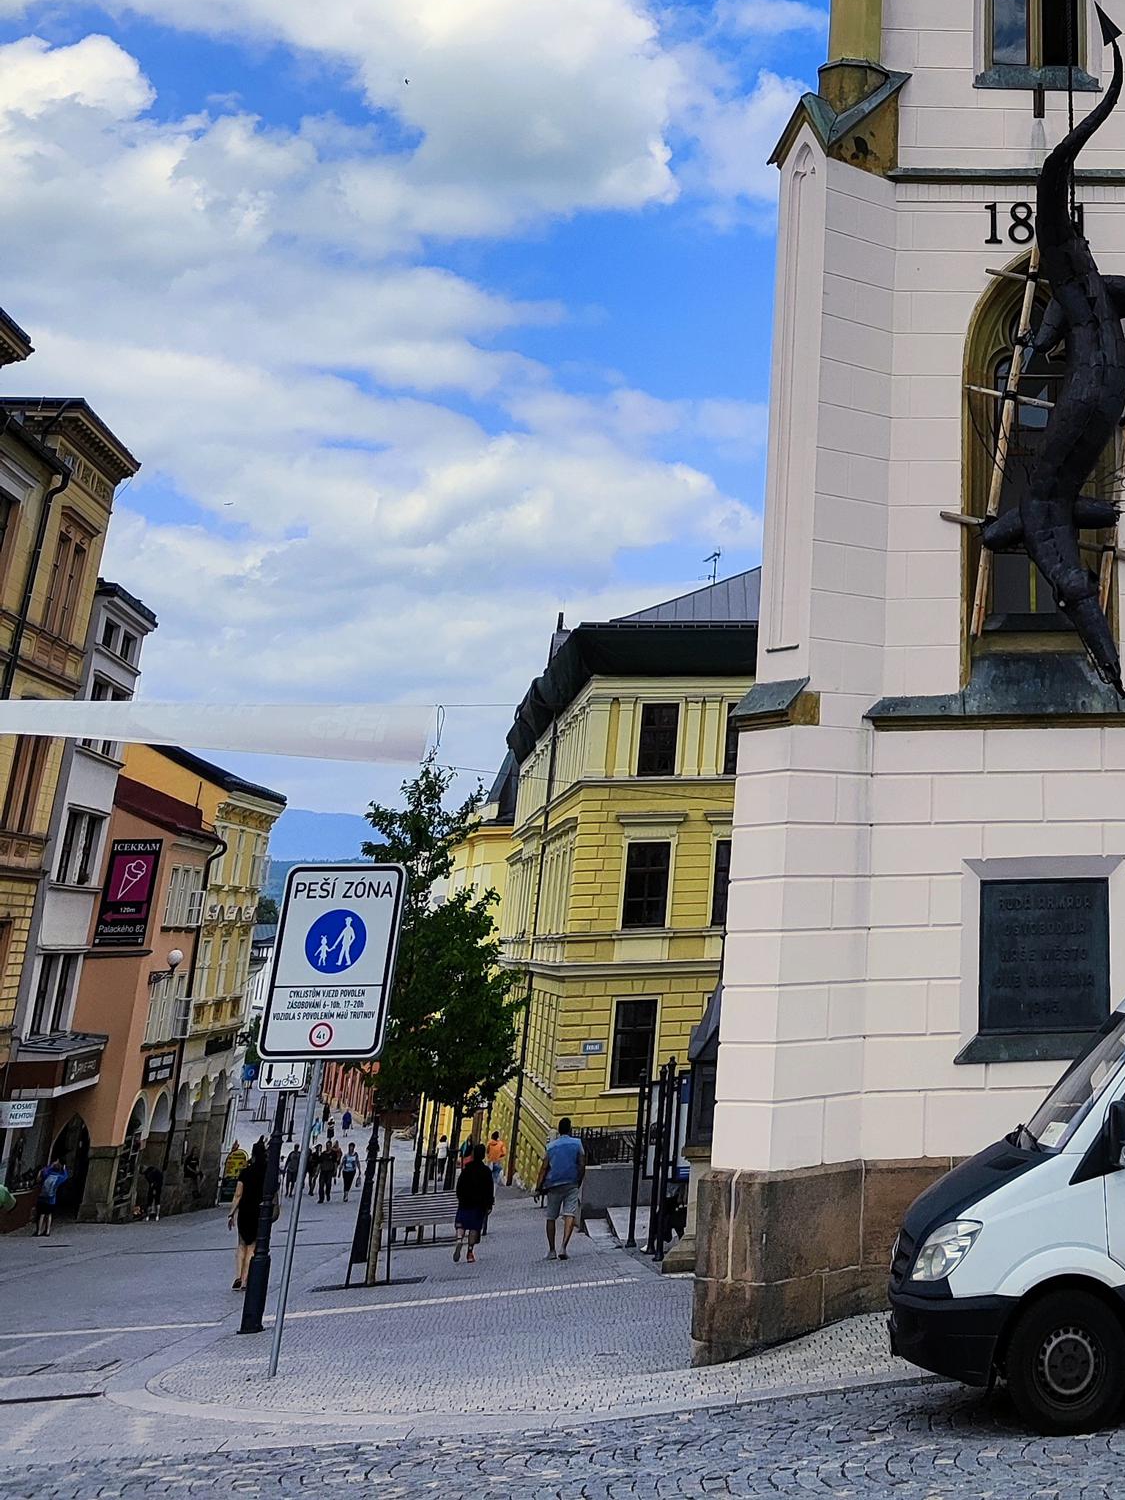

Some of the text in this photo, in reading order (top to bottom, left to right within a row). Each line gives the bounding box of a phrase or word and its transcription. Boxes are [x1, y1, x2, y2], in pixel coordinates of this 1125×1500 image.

[113, 843, 161, 852] ICEKRAM
[293, 876, 394, 900] PEŠÍ ZÓNA
[97, 924, 145, 934] Palackého 82
[288, 987, 366, 998] CYKLISTŮM VJEZD POVOLEN
[286, 999, 322, 1010] ZÁSOBOVÁNÍ
[272, 1012, 296, 1021] VOZIDLA
[301, 1009, 335, 1020] POVOLENÍM
[349, 1010, 376, 1020] TRUTNOV
